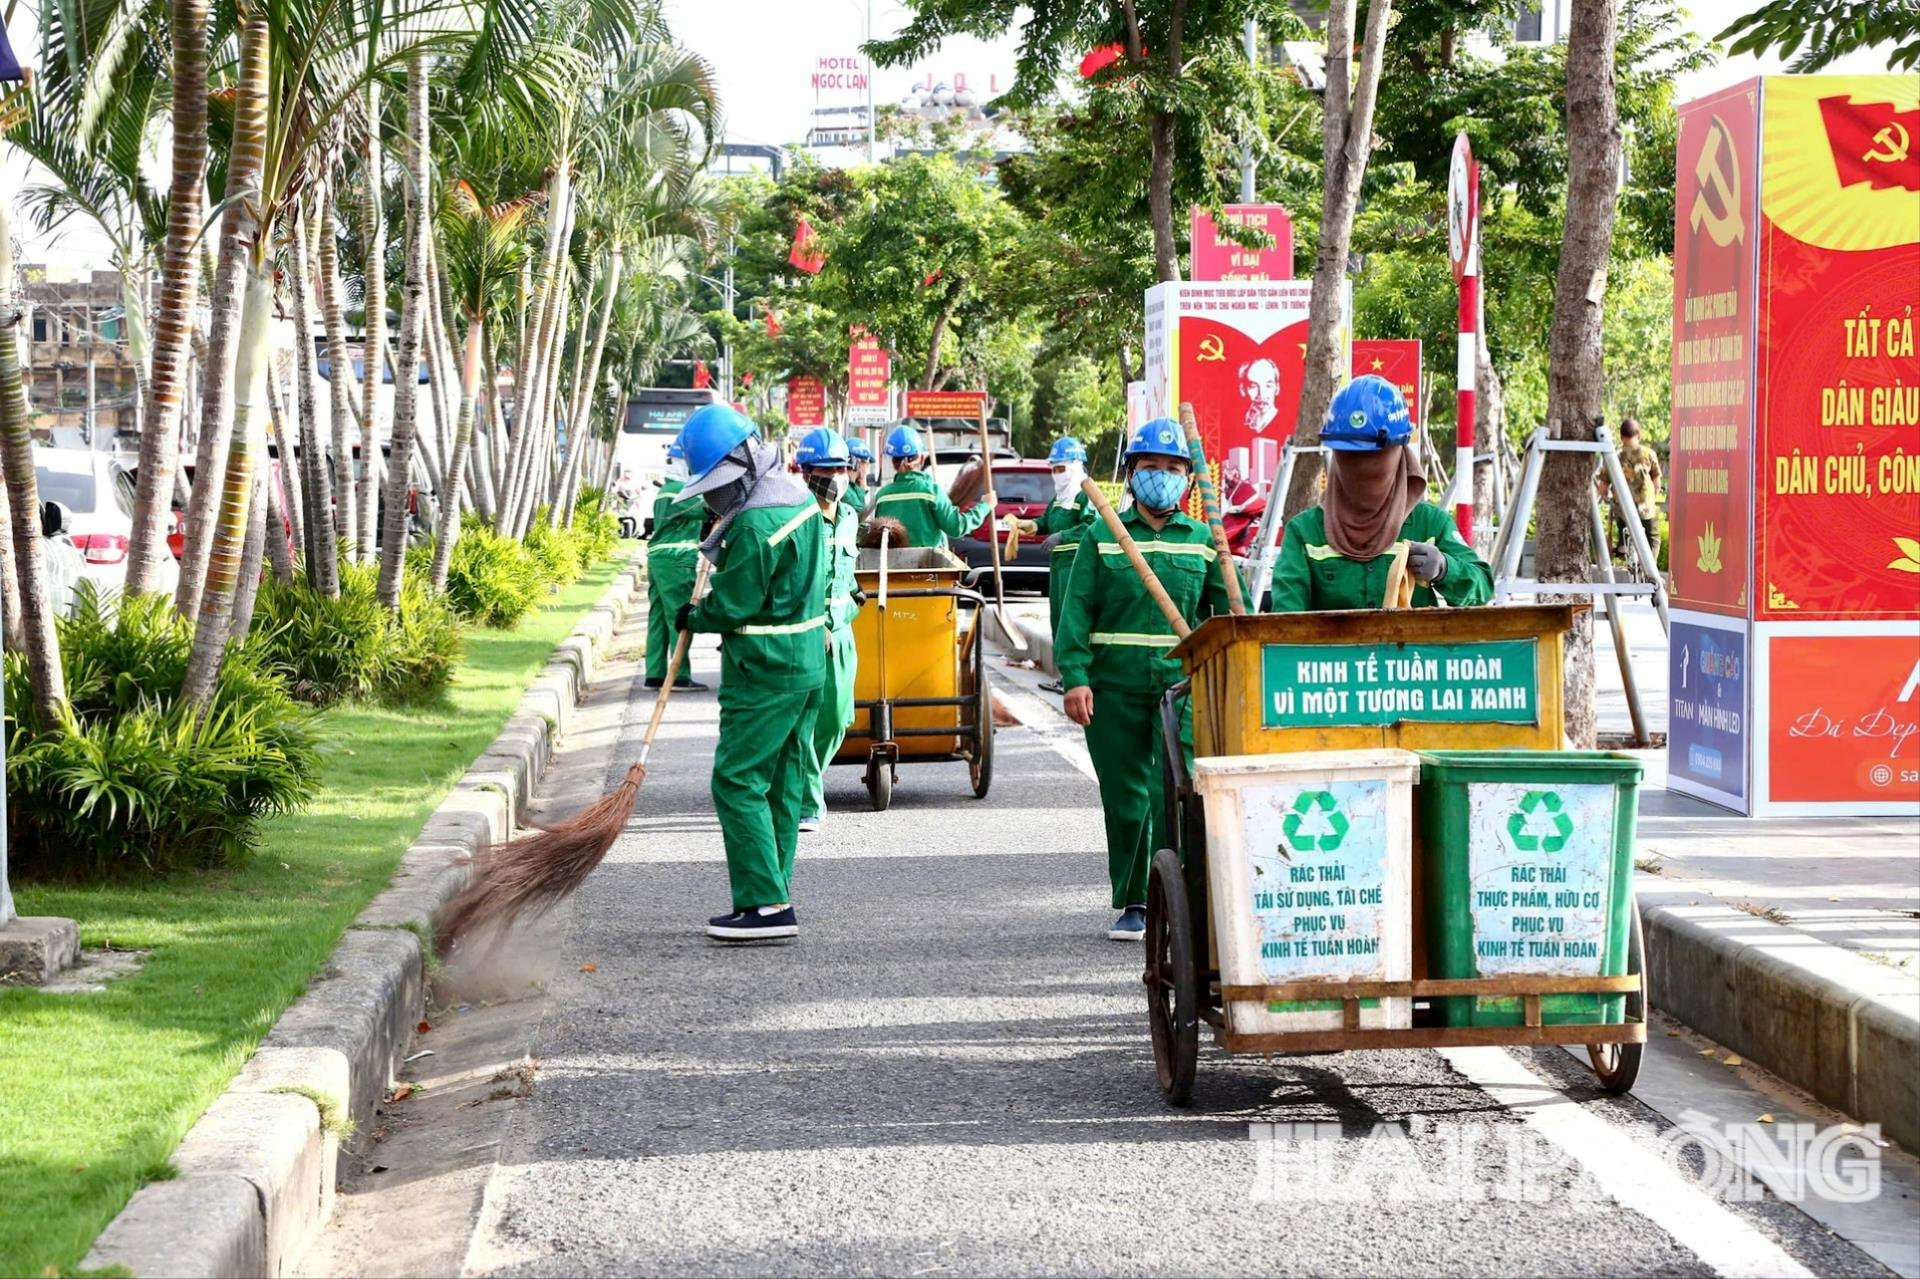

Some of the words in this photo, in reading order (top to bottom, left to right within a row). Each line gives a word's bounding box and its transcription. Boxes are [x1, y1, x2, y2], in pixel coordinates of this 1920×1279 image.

[819, 58, 859, 69] HOTEL
[846, 74, 867, 89] LAN
[1844, 305, 1881, 357] TẤT
[1886, 305, 1915, 357] CẢ
[1821, 379, 1864, 426] DÂN
[1871, 378, 1919, 426] GIÀU
[1776, 448, 1818, 494] DÂN
[1824, 442, 1872, 499] CHỦ,
[1297, 661, 1348, 684] KINH
[1355, 652, 1378, 682] TẾ
[1385, 651, 1438, 681] TUẦN
[1446, 654, 1502, 681] HOÀN
[1274, 687, 1294, 714] VÌ
[1302, 687, 1349, 718] MỘT
[1356, 687, 1424, 713] TƯƠNG
[1431, 688, 1463, 710] LAI
[1470, 687, 1527, 710] XANH
[1674, 699, 1694, 720] TITAN
[1728, 711, 1740, 735] LED
[1789, 707, 1844, 738] Đá
[1853, 707, 1919, 758] Đẹp
[1290, 863, 1315, 883] RÁC
[1318, 860, 1345, 882] THẢI
[1511, 863, 1536, 883] RÁC
[1539, 862, 1567, 883] THẢI
[1296, 890, 1334, 911] DỤNG,
[1359, 882, 1383, 905] CHẾ
[1477, 890, 1508, 911] THỰC
[1555, 889, 1580, 908] HỮU
[1294, 915, 1327, 935] PHỤC
[1330, 914, 1346, 934] VỤ
[1512, 916, 1545, 936] PHỤC
[1548, 917, 1564, 937] VỤ
[1262, 941, 1291, 958] KINH
[1294, 936, 1309, 957] TẾ
[1478, 941, 1507, 957] KINH
[1510, 936, 1525, 957] TẾ
[1564, 938, 1597, 958] HOÀN
